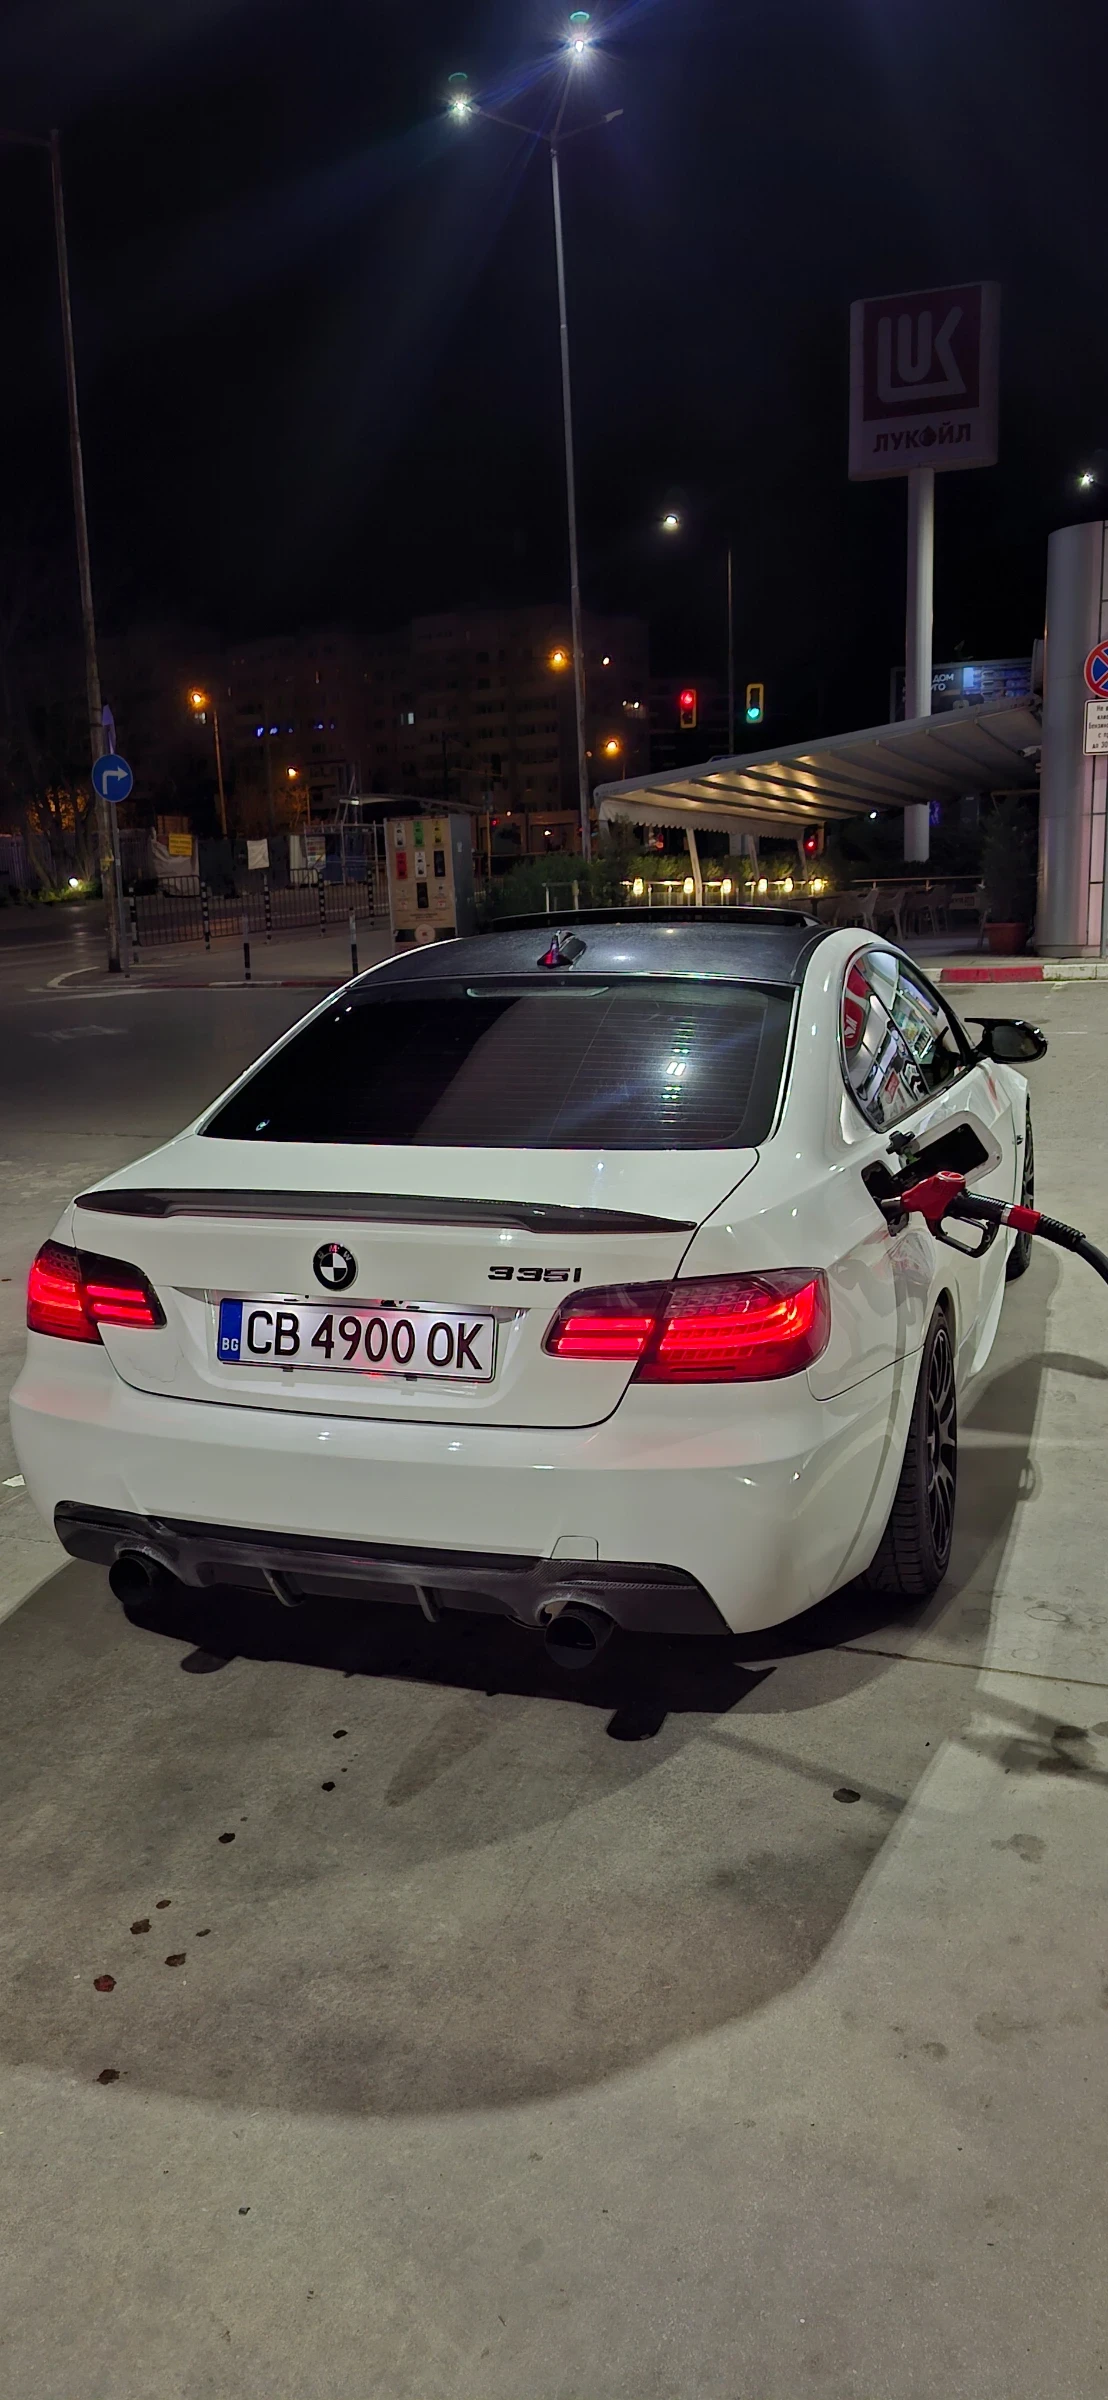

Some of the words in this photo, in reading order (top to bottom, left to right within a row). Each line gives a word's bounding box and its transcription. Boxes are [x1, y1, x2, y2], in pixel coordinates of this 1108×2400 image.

[873, 421, 971, 453] ЛУКОЙЛ
[317, 1244, 352, 1261] BMW
[222, 1337, 239, 1351] BG
[247, 1310, 300, 1356] CB
[311, 1314, 415, 1364] 4900
[427, 1322, 483, 1370] OK
